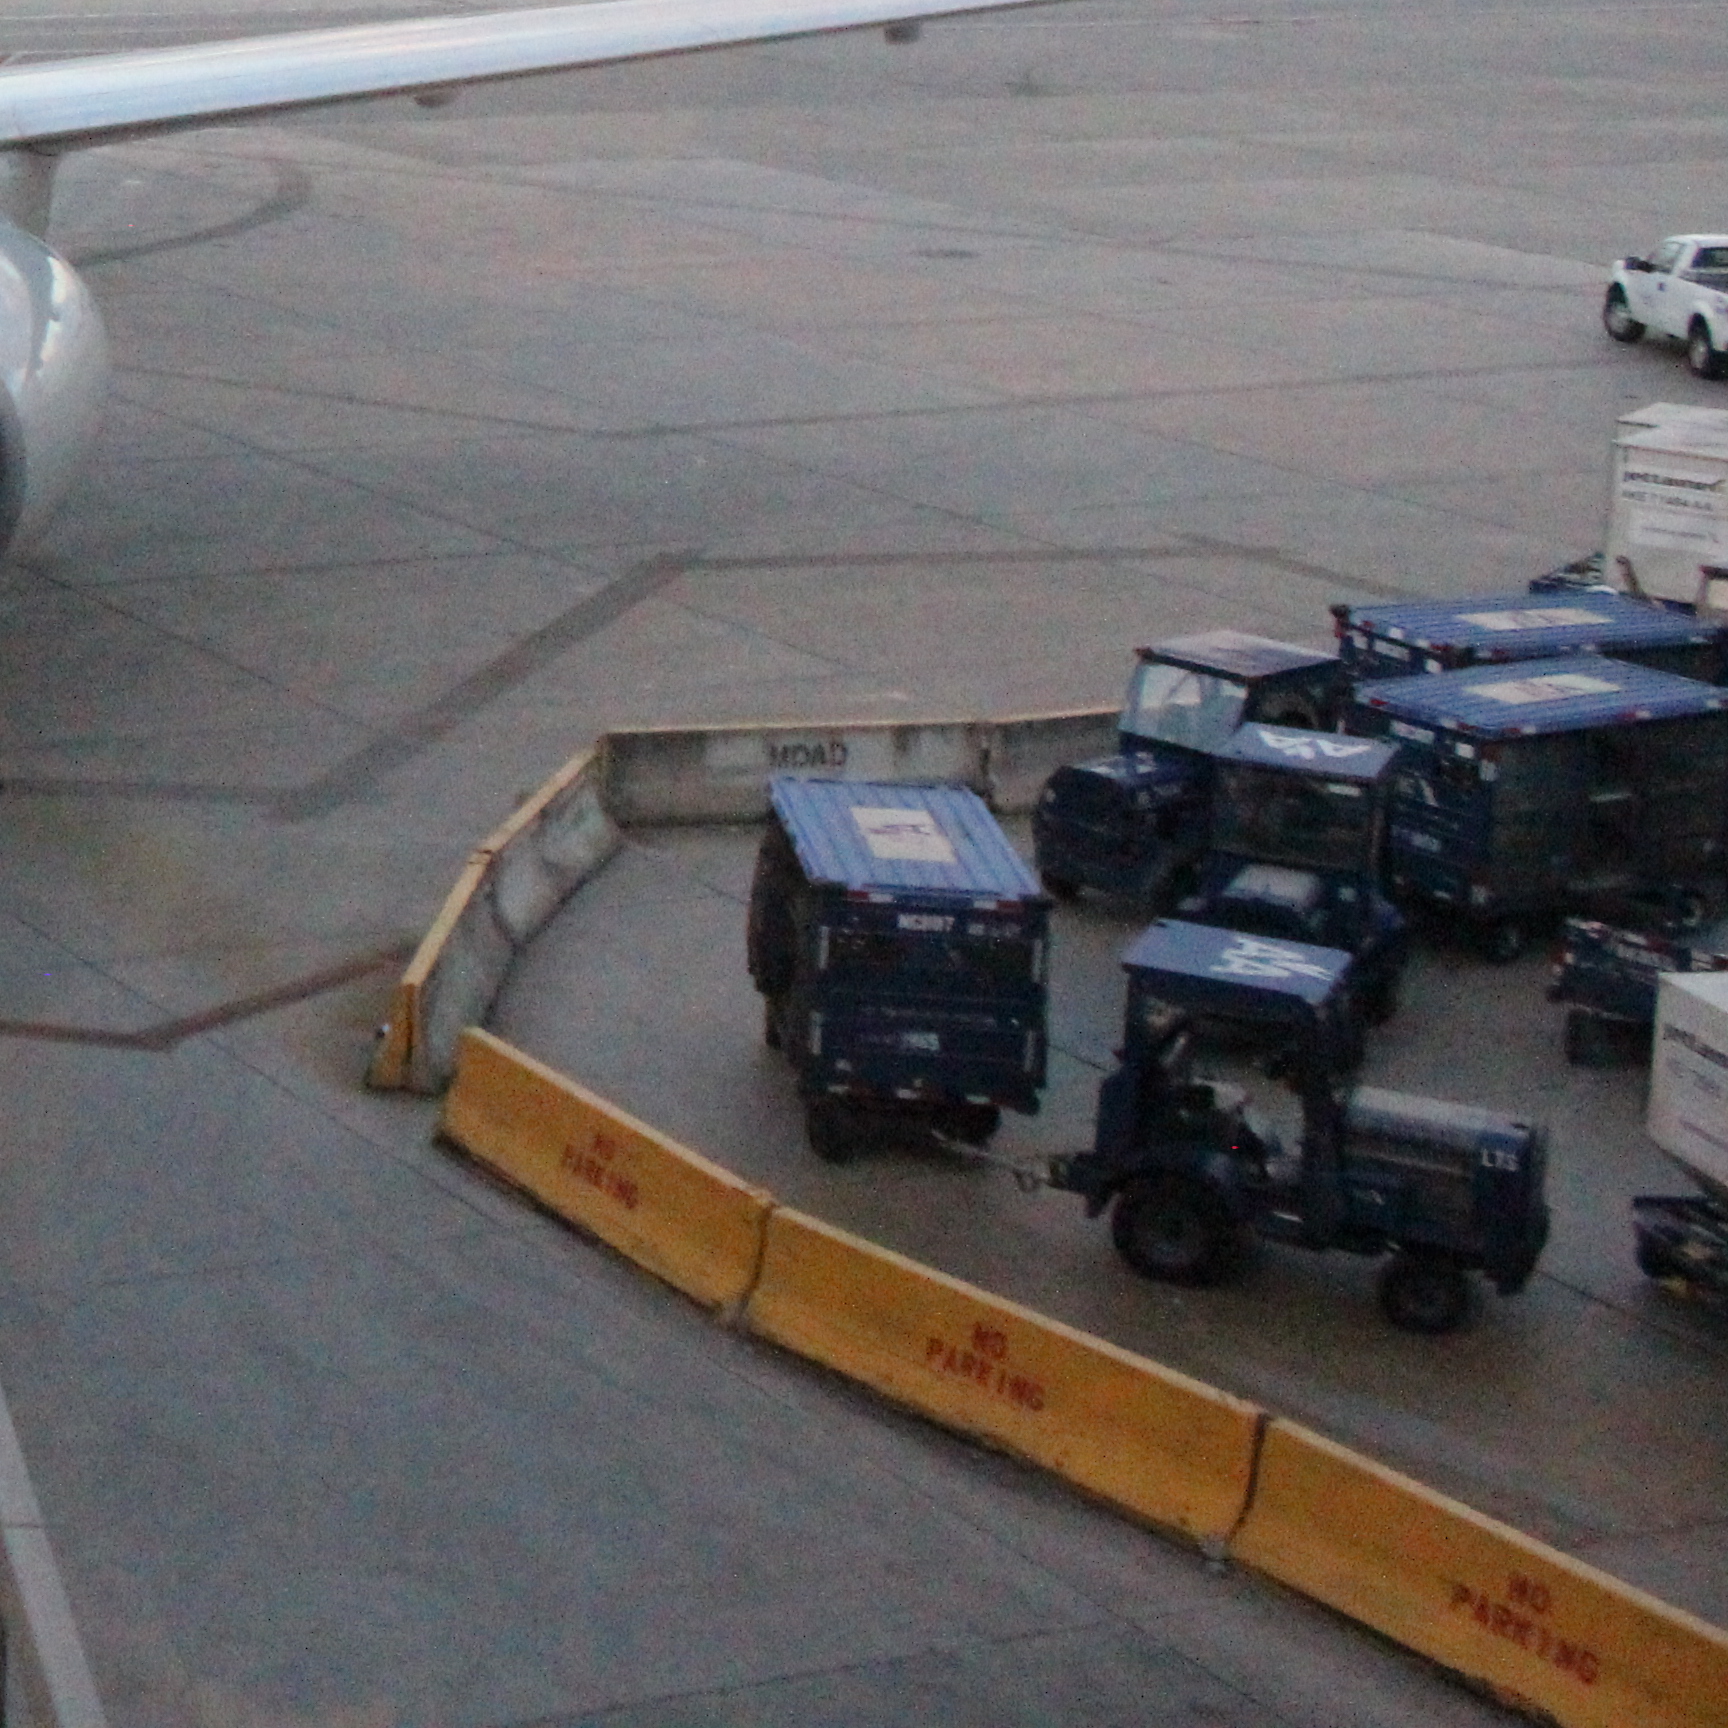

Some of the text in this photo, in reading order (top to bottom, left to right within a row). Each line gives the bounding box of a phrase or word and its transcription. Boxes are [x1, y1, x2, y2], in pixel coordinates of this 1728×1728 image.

[971, 1321, 1009, 1360] NO
[926, 1336, 1046, 1413] PARKING
[1507, 1569, 1553, 1615] NO
[1448, 1582, 1600, 1686] PARKING
